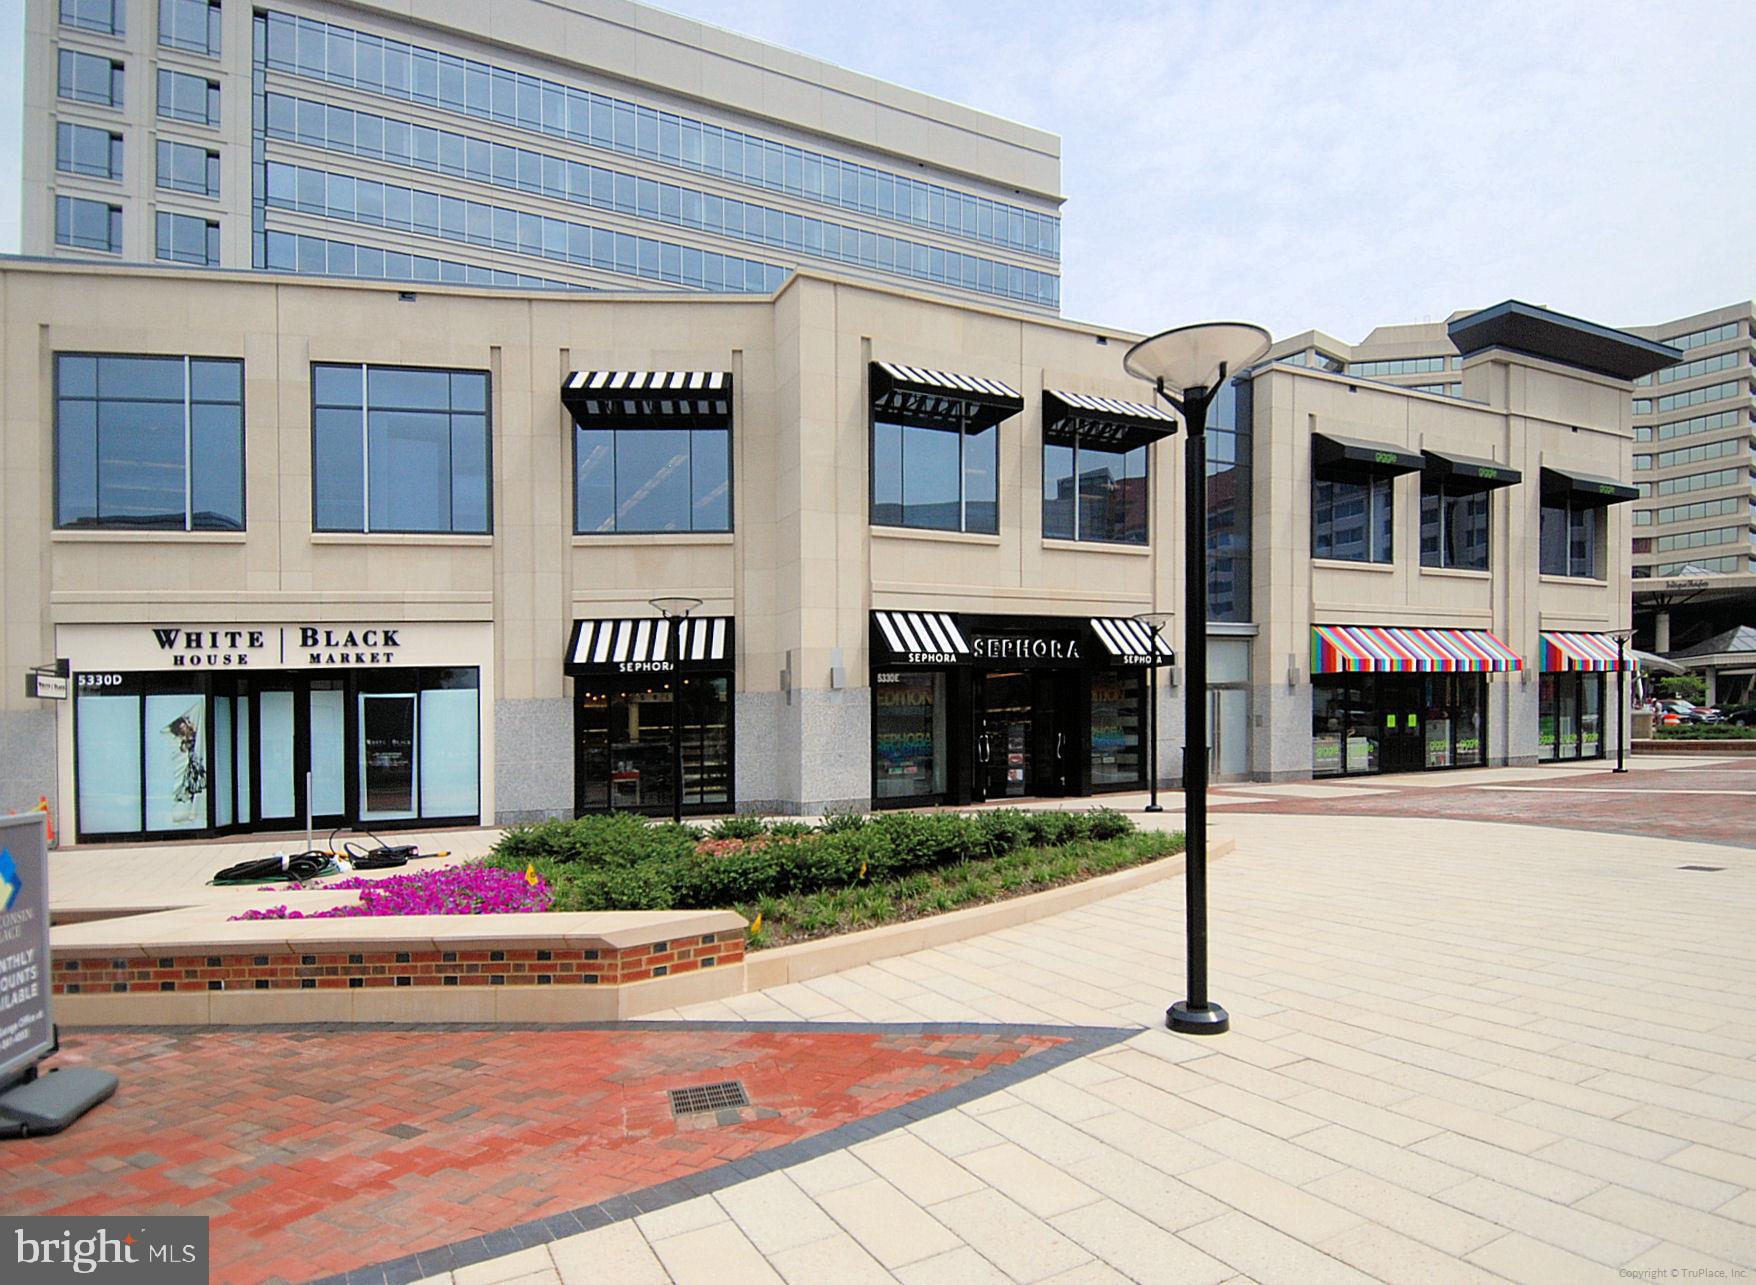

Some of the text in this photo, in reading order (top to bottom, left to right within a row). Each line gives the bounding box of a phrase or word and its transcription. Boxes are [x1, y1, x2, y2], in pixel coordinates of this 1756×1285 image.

[151, 628, 264, 649] WHITE
[299, 627, 400, 648] BLACK
[973, 638, 1080, 659] SEPHORA
[173, 653, 249, 666] HOUSE
[309, 652, 394, 665] MARKET
[908, 652, 957, 663] SEPHORA
[1123, 655, 1162, 664] SEPHOA
[78, 674, 122, 686] 5330D
